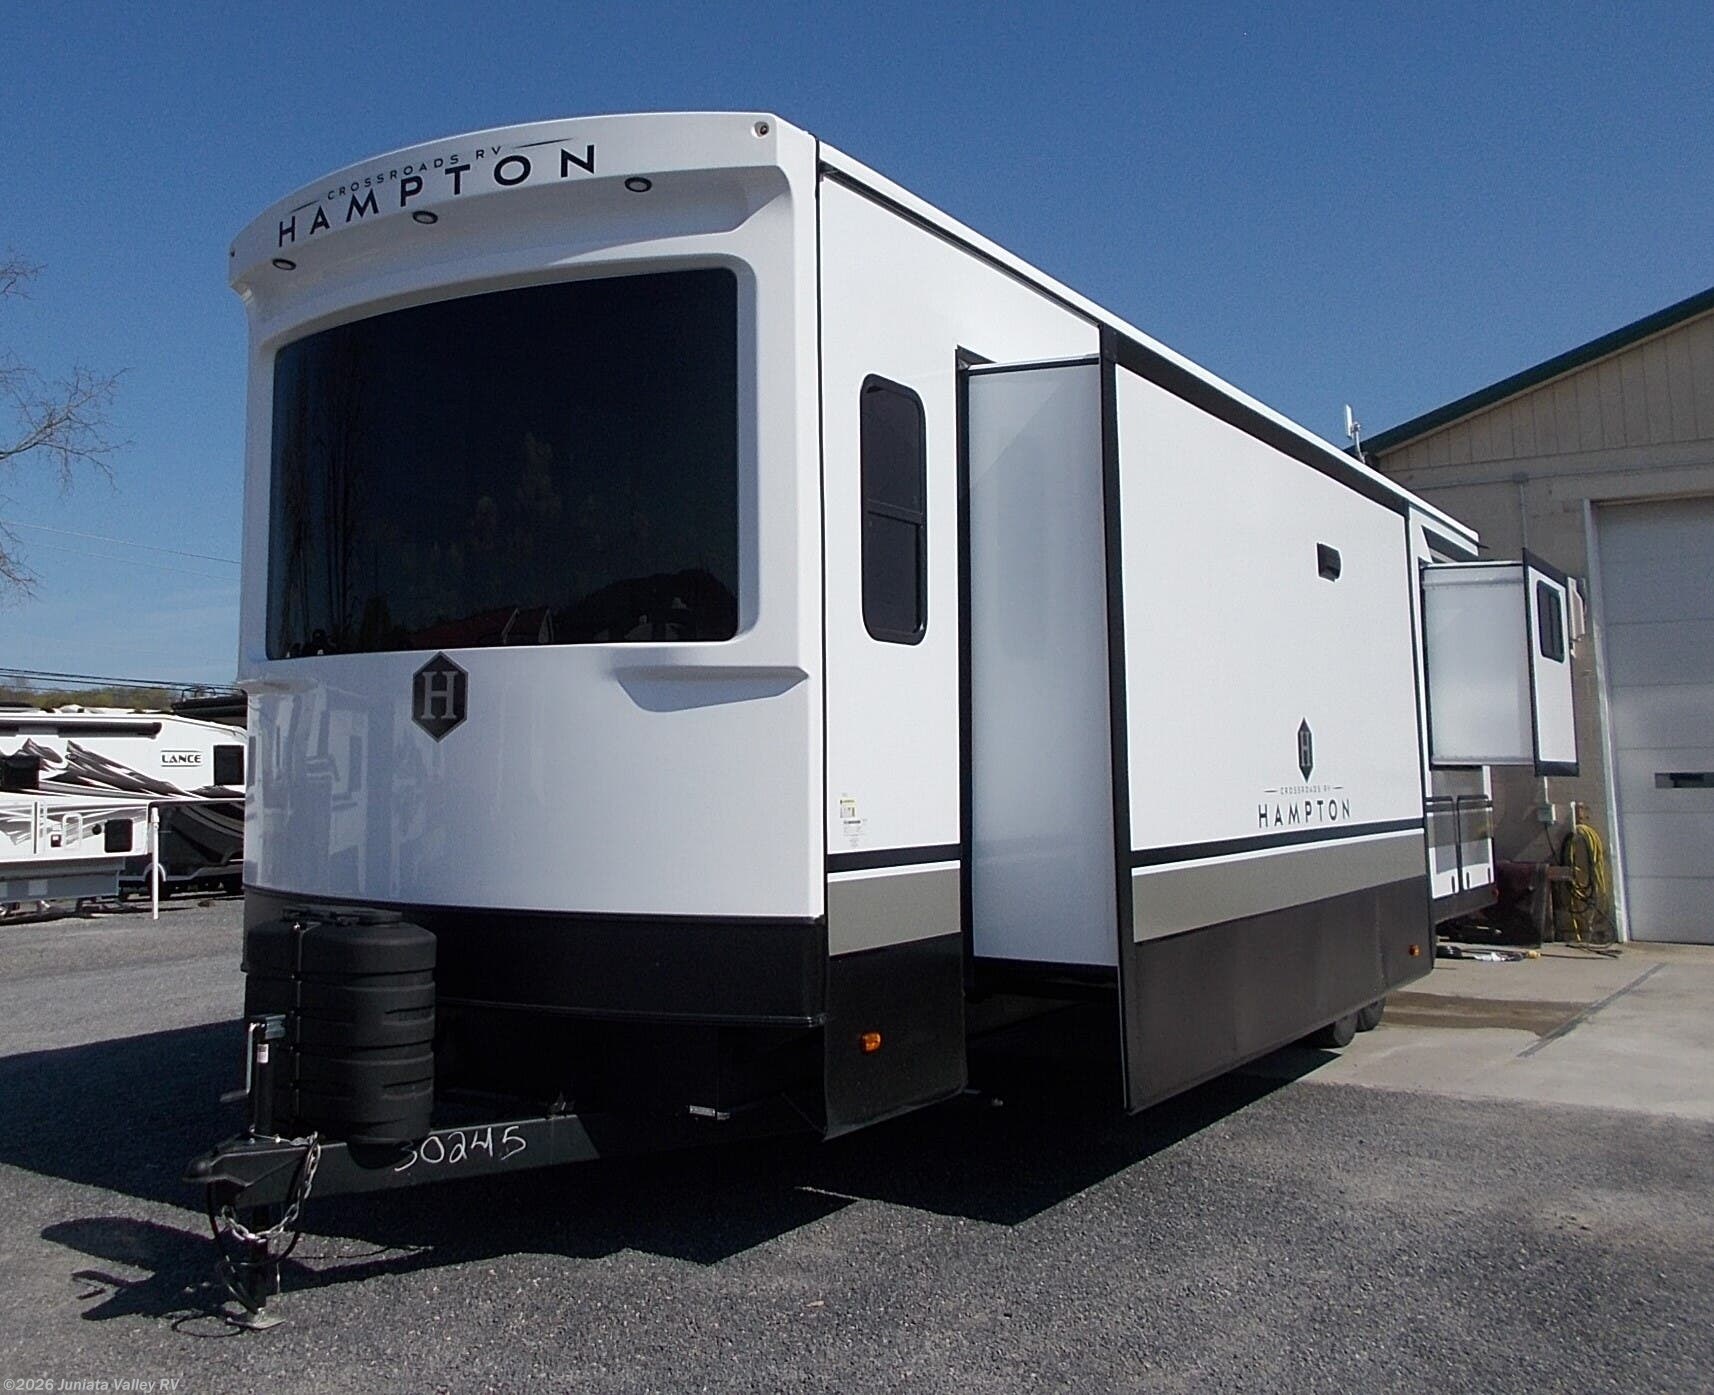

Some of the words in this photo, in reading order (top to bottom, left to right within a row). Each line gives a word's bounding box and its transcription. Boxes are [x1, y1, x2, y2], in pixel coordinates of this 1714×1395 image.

[278, 144, 597, 247] HAMPTON
[327, 154, 459, 200] CROSSROADS
[475, 146, 501, 160] RV
[421, 671, 458, 719] H
[161, 754, 202, 764] LANCE
[1258, 799, 1351, 828] HAMPTON
[394, 1126, 526, 1172] 30245
